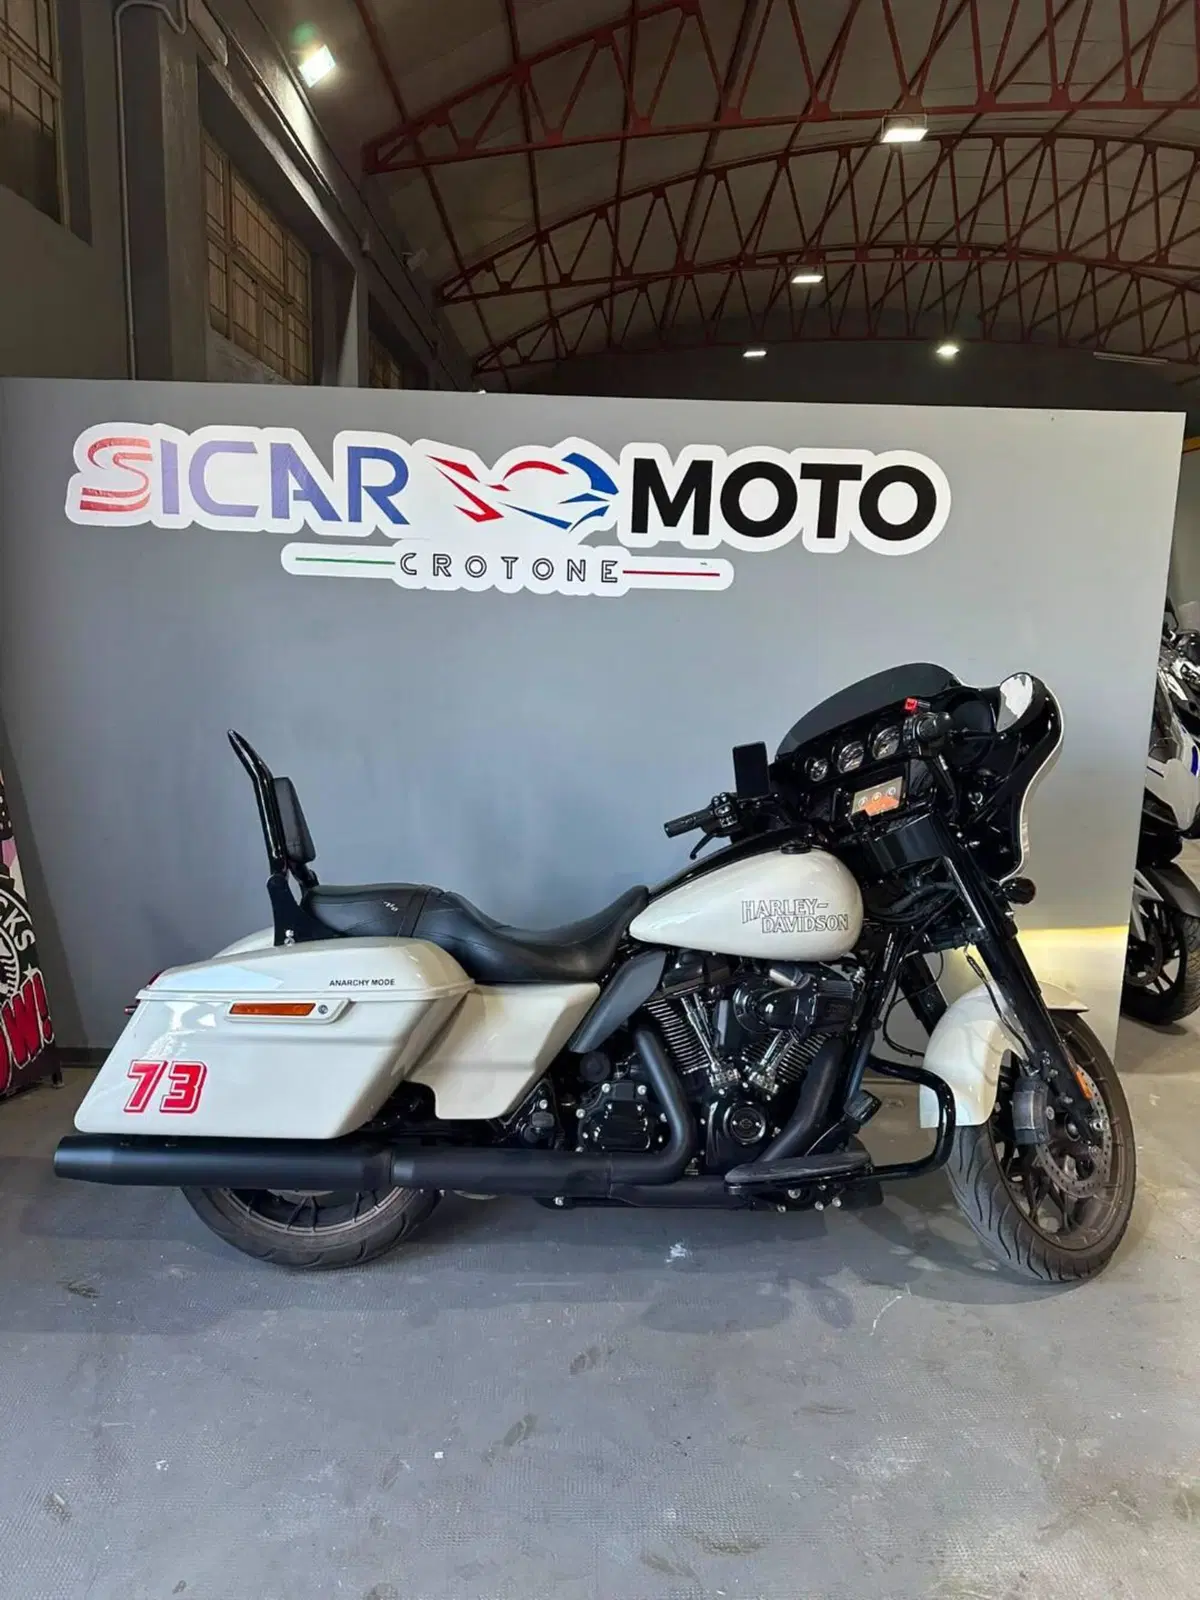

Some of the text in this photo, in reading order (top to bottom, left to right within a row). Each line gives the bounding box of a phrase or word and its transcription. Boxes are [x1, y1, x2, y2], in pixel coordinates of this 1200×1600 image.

[79, 437, 937, 541] SICAR MOTO
[400, 552, 618, 583] CROTONE
[761, 914, 849, 933] DAVIDSON
[329, 978, 395, 987] ANARCHY MODE
[123, 1059, 208, 1114] 73
